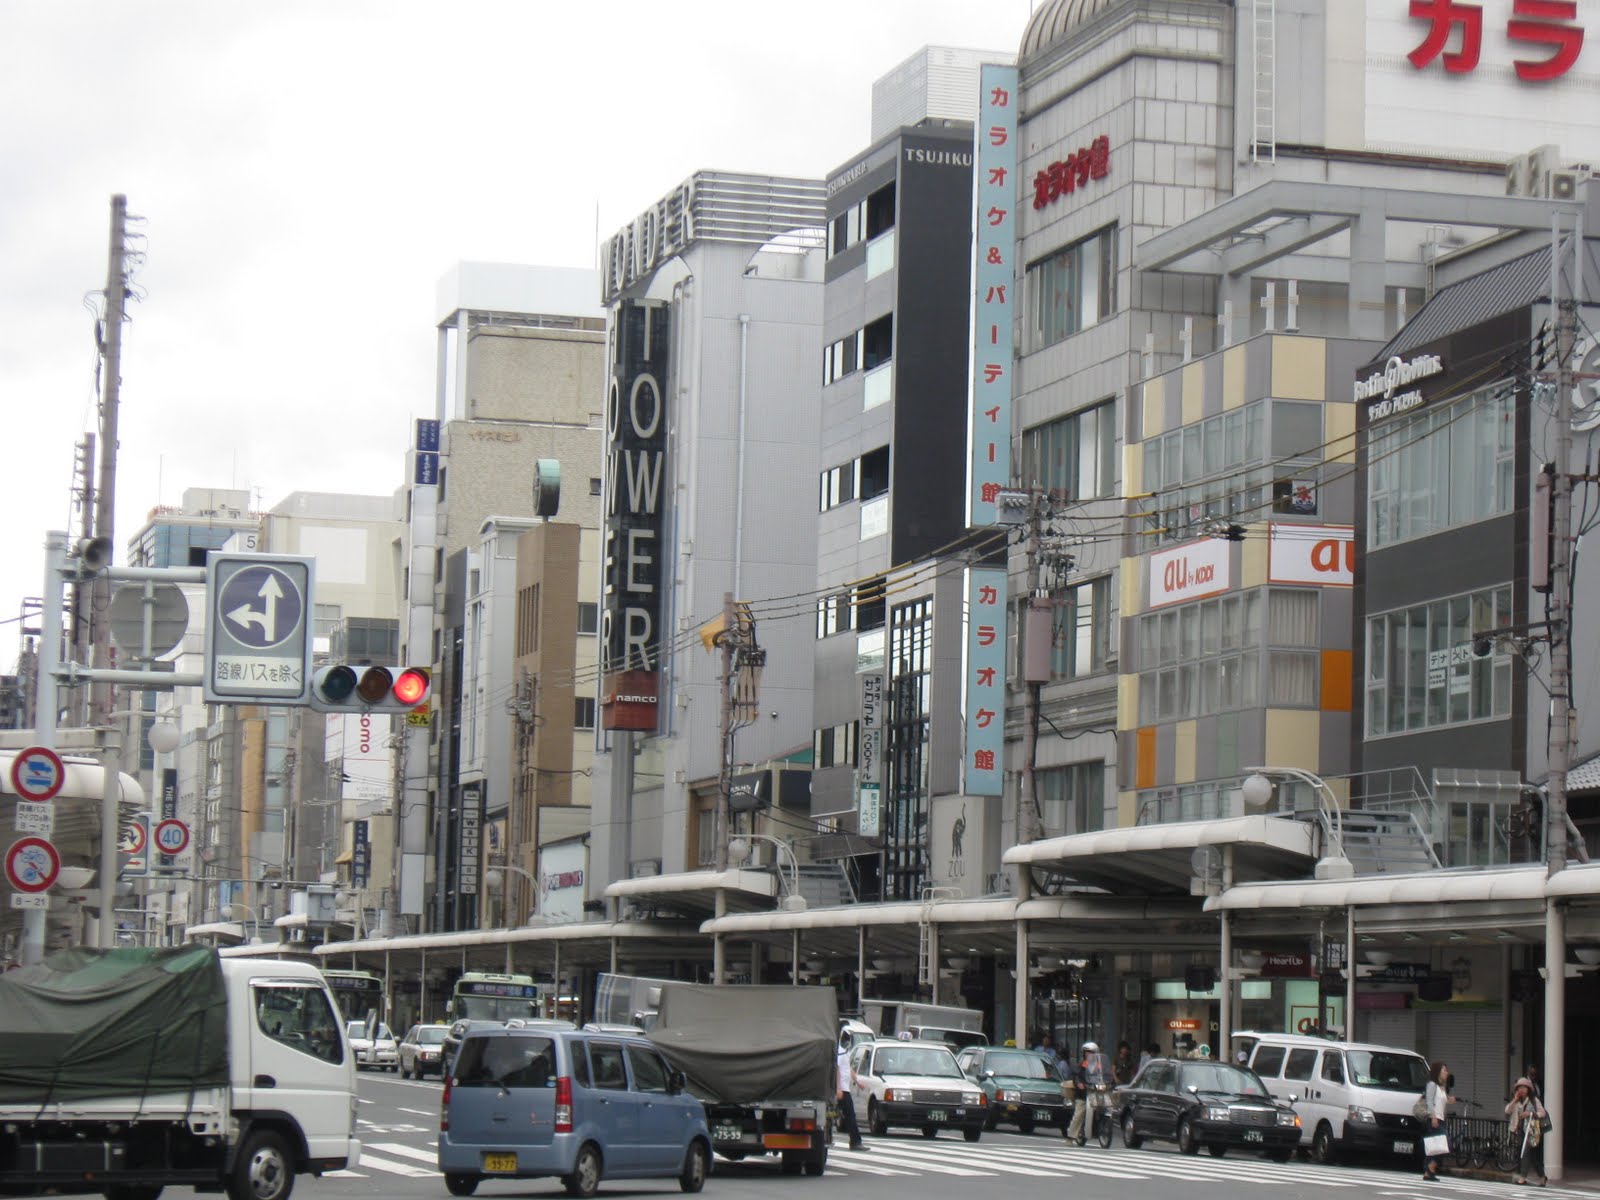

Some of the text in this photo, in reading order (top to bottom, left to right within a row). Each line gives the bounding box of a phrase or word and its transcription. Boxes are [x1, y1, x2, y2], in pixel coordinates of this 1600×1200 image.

[1407, 0, 1585, 81] カラ
[905, 148, 972, 166] TSUJIKU
[600, 179, 695, 303] WONDER
[981, 87, 1009, 503] カラオケ&パーティー館
[623, 299, 666, 672] TOWER
[1164, 557, 1187, 592] au
[217, 662, 300, 682] 路線バスを除く
[974, 585, 998, 771] カラオケ館
[616, 694, 657, 703] namco
[864, 679, 874, 726] サクラヤ
[165, 785, 173, 802] THE
[162, 829, 182, 845] 40
[718, 1130, 741, 1140] 75-99
